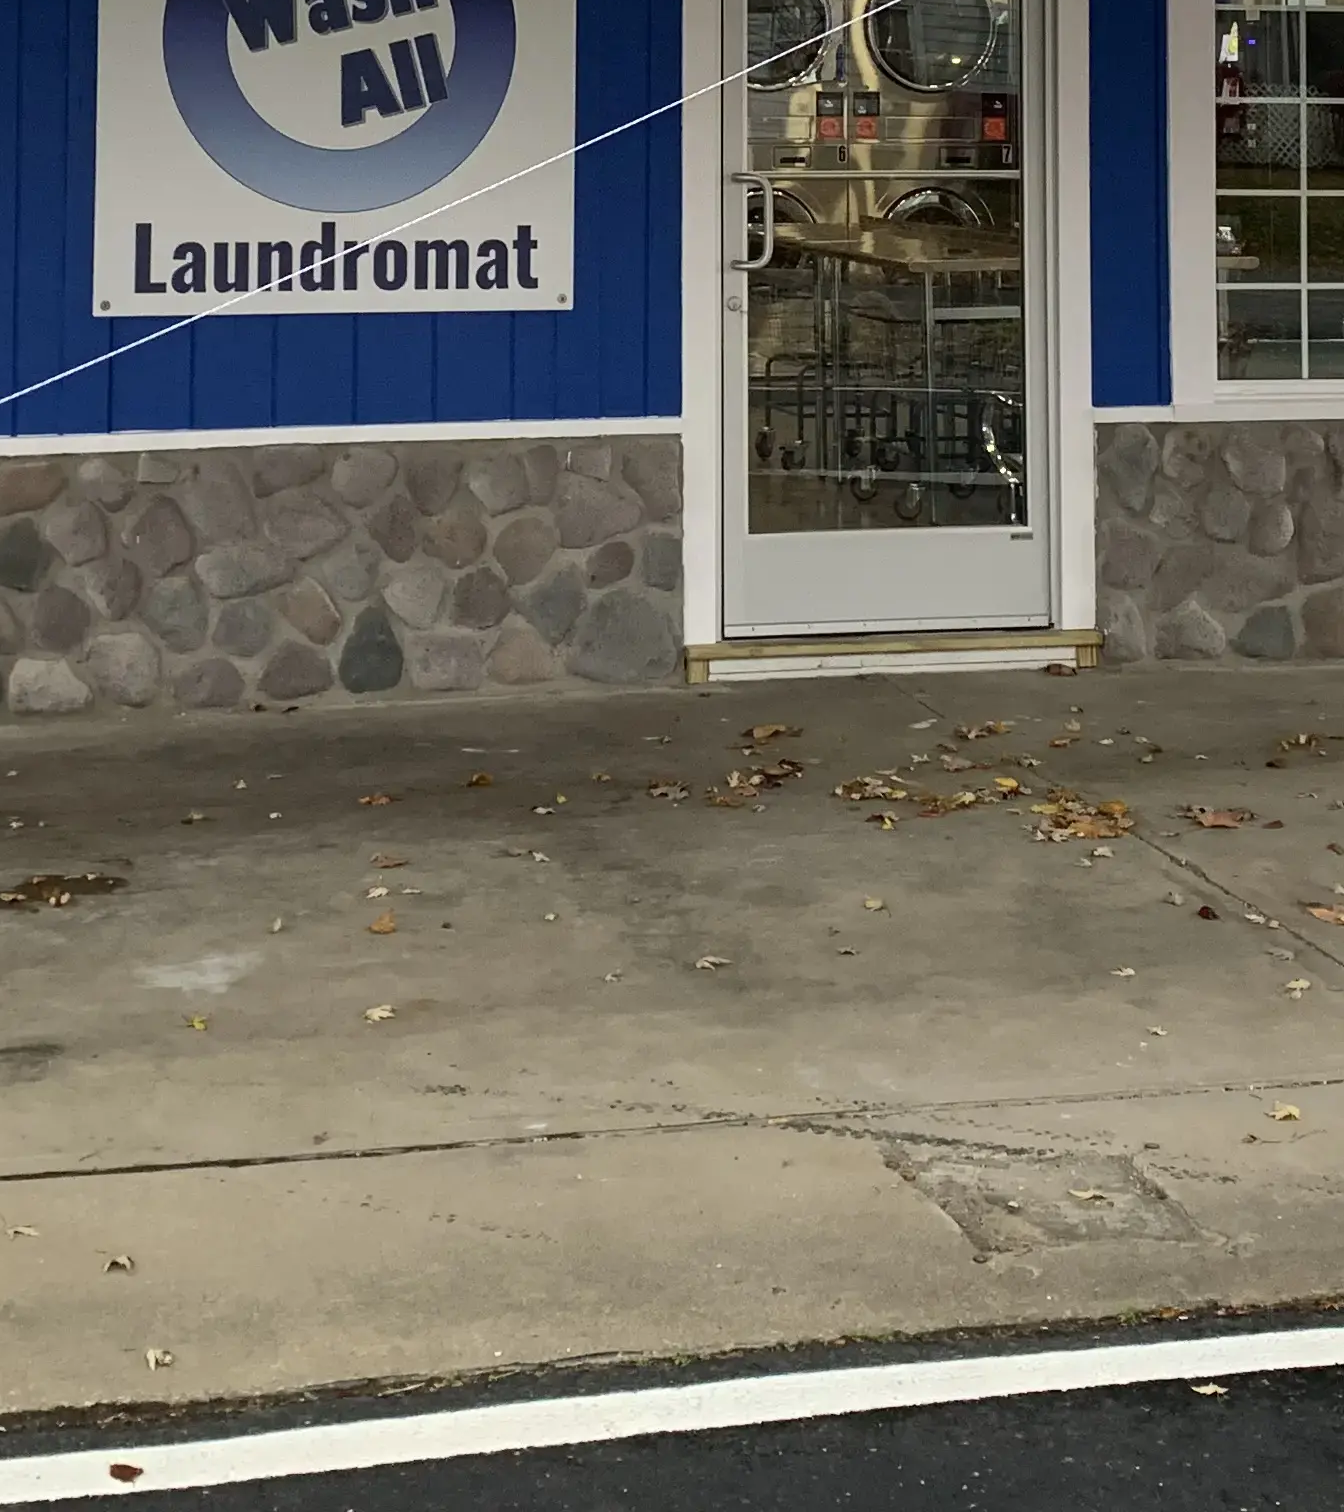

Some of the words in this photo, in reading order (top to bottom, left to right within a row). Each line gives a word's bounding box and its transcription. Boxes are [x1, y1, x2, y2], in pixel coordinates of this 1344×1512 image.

[341, 32, 449, 128] All
[838, 146, 847, 162] 6
[1004, 144, 1012, 162] 7
[134, 221, 539, 294] Laundromat
